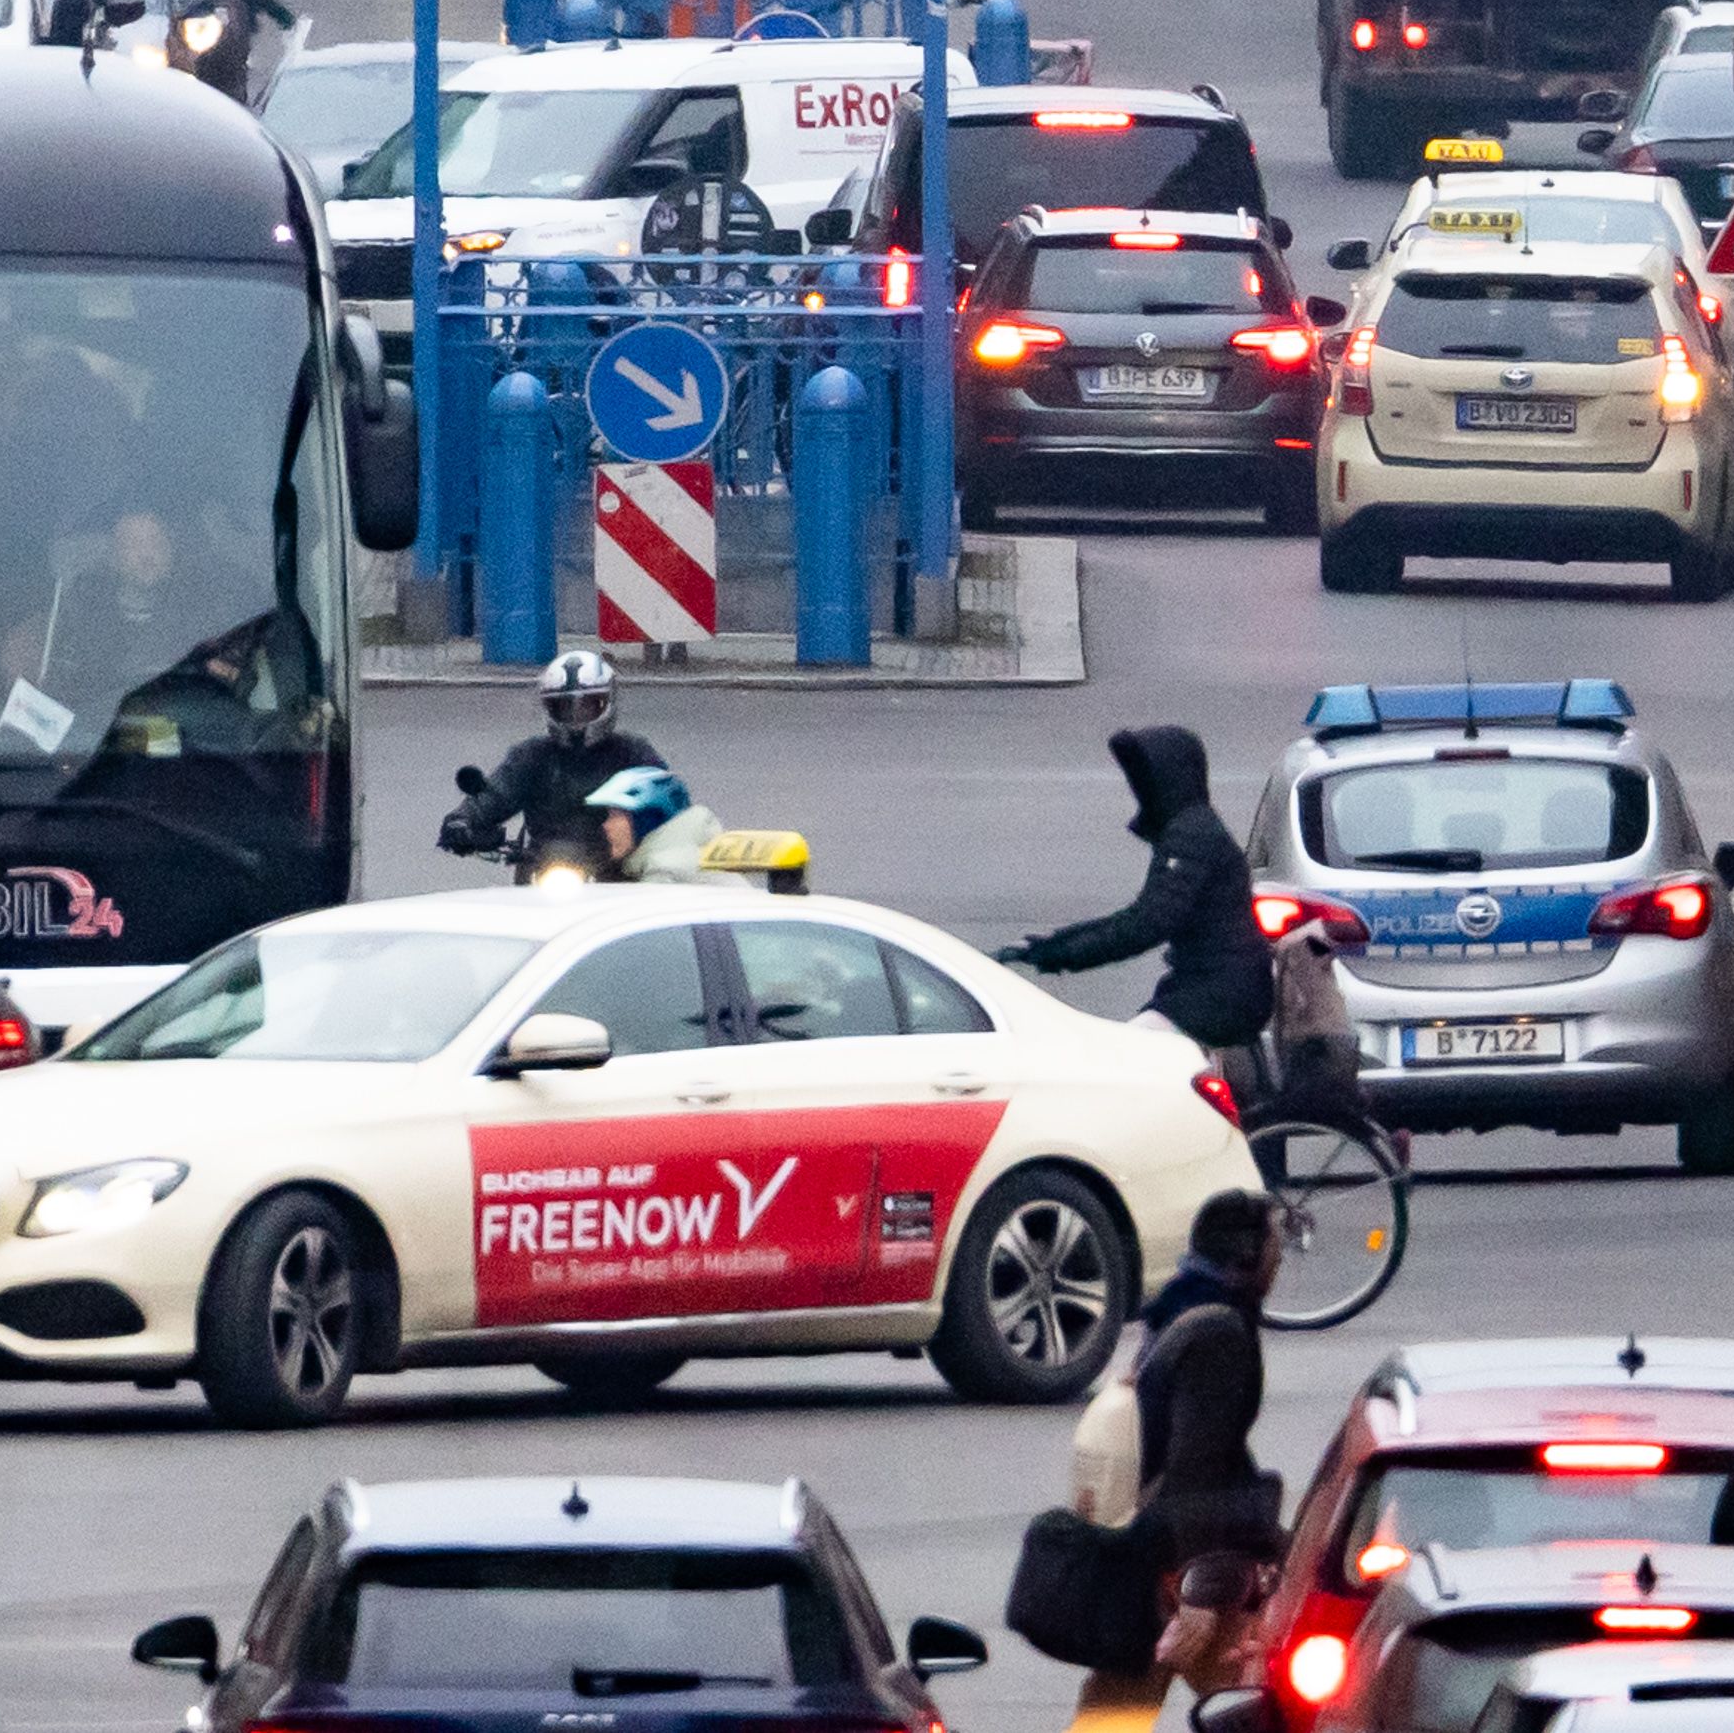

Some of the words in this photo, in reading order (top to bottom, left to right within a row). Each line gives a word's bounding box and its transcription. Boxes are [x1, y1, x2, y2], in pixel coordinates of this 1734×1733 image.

[1439, 144, 1489, 159] TAXI
[1105, 368, 1120, 388] B
[1161, 367, 1197, 390] 639
[1525, 401, 1574, 426] 2305
[1436, 1030, 1453, 1056] B
[1471, 1028, 1539, 1054] 7122
[480, 1166, 601, 1195] BUCHBAR
[606, 1164, 657, 1187] AUF
[480, 1191, 722, 1256] FREENOW
[672, 1251, 700, 1278] für
